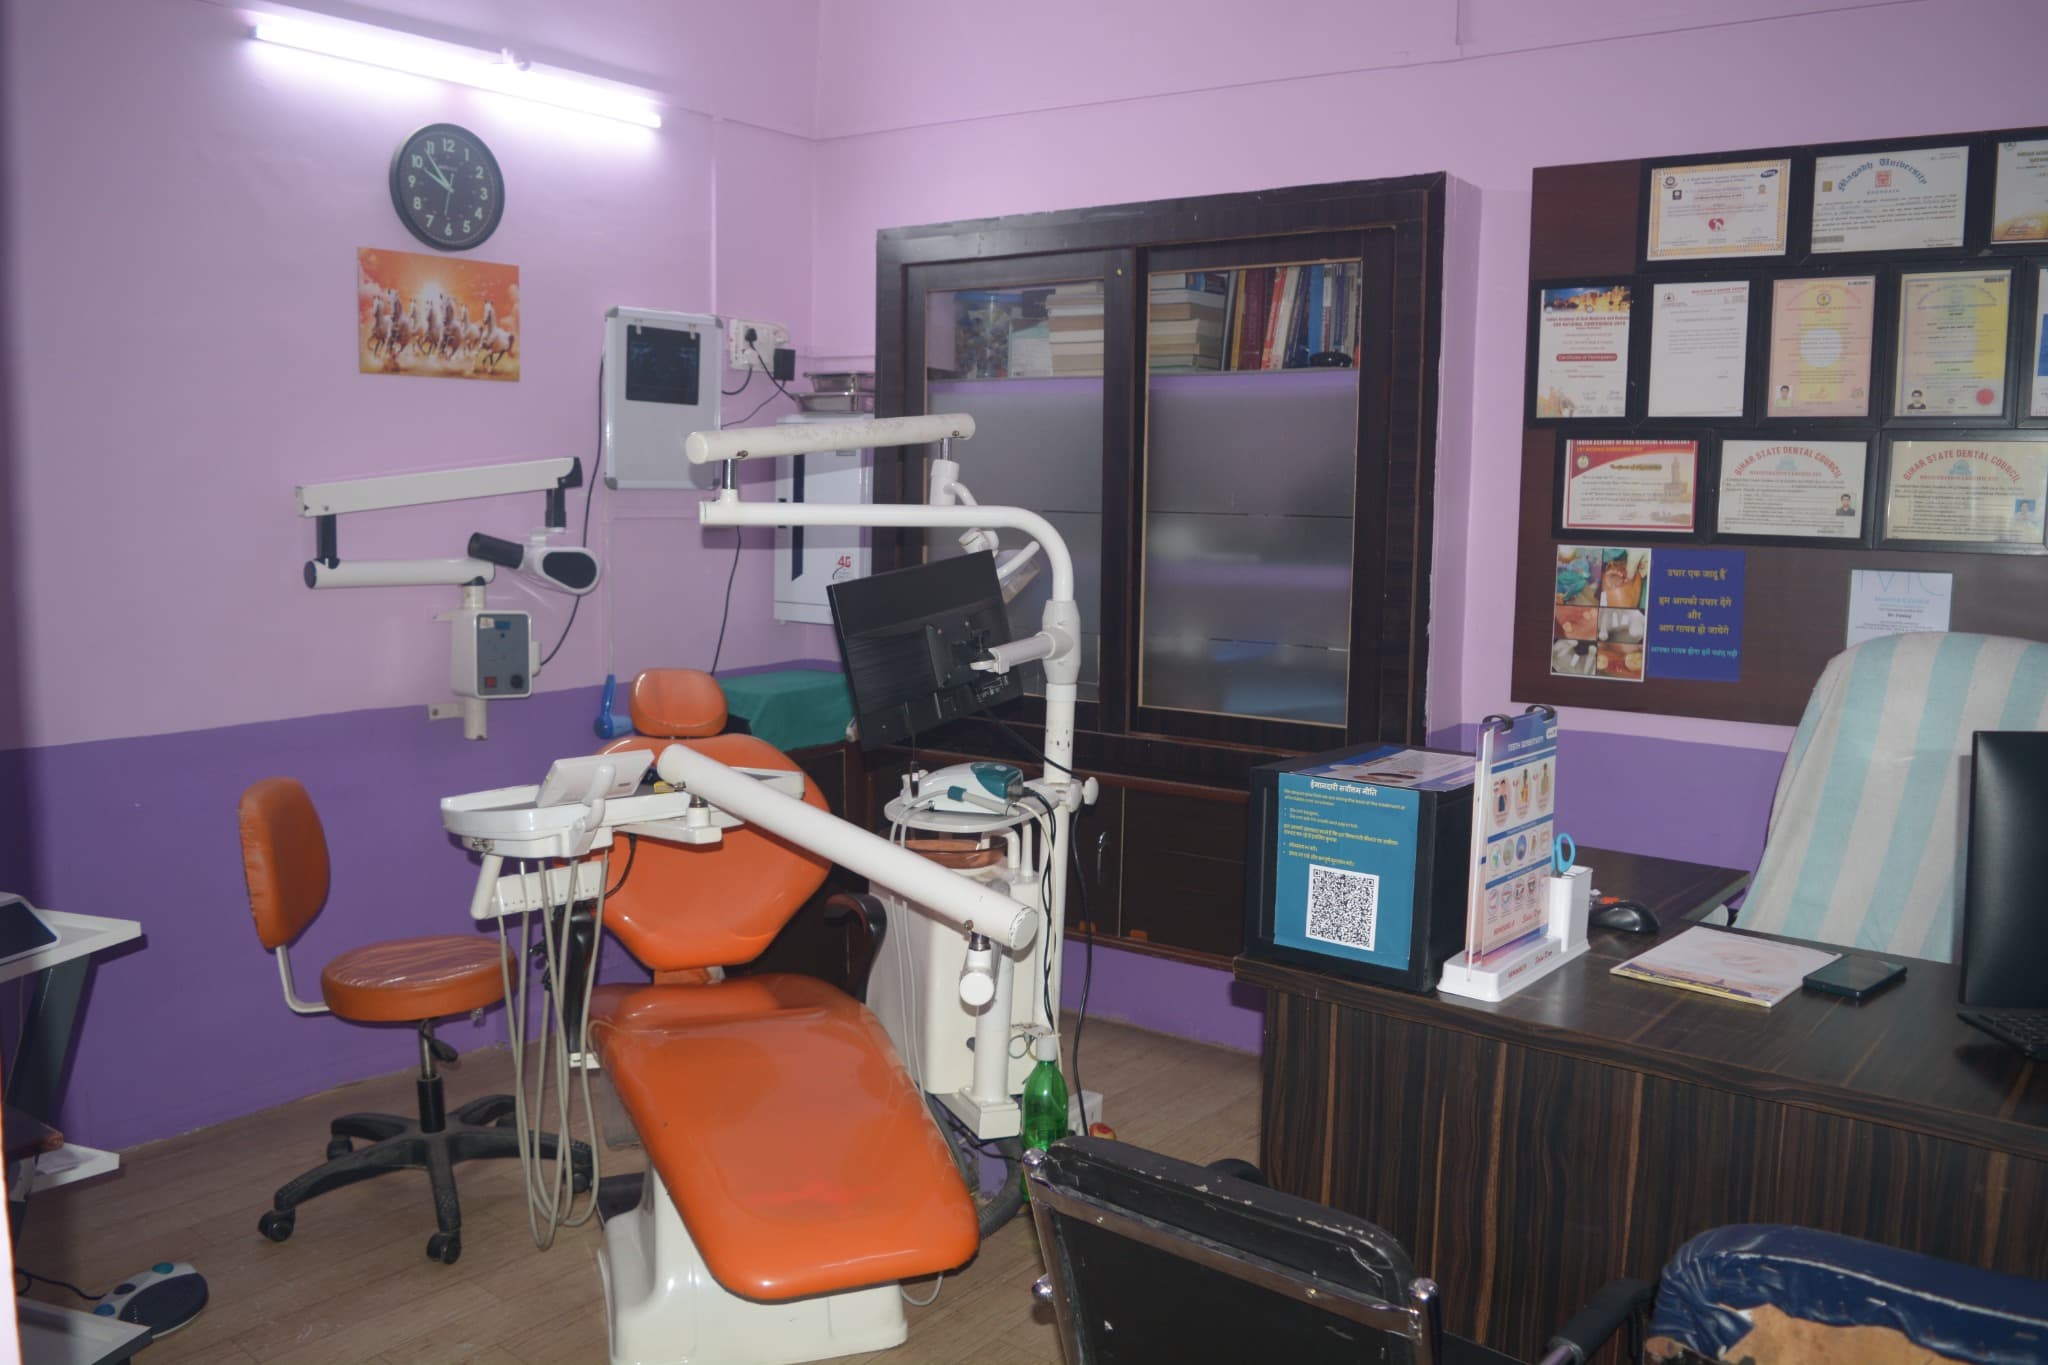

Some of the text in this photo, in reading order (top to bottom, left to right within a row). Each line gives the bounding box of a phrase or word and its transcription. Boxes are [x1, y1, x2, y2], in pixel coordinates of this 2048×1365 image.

[426, 140, 435, 154] 11
[443, 138, 456, 152] 12
[411, 154, 423, 168] 10
[464, 148, 469, 161] 1
[476, 166, 484, 179] 2
[1879, 158, 1928, 185] University
[408, 176, 416, 188] 9
[480, 188, 488, 200] 3
[414, 196, 422, 210] 8
[474, 208, 482, 220] 4
[426, 214, 434, 228] 7
[463, 220, 471, 233] 5
[444, 223, 452, 236] 6
[1734, 456, 1756, 476] BIHAR
[1756, 447, 1780, 460] STATE
[1782, 446, 1814, 458] DENTAL
[1814, 452, 1841, 479] COUNCIL
[1903, 449, 2022, 483] BIHAR STATE DENTAL COUNCIL
[837, 556, 852, 568] 4G
